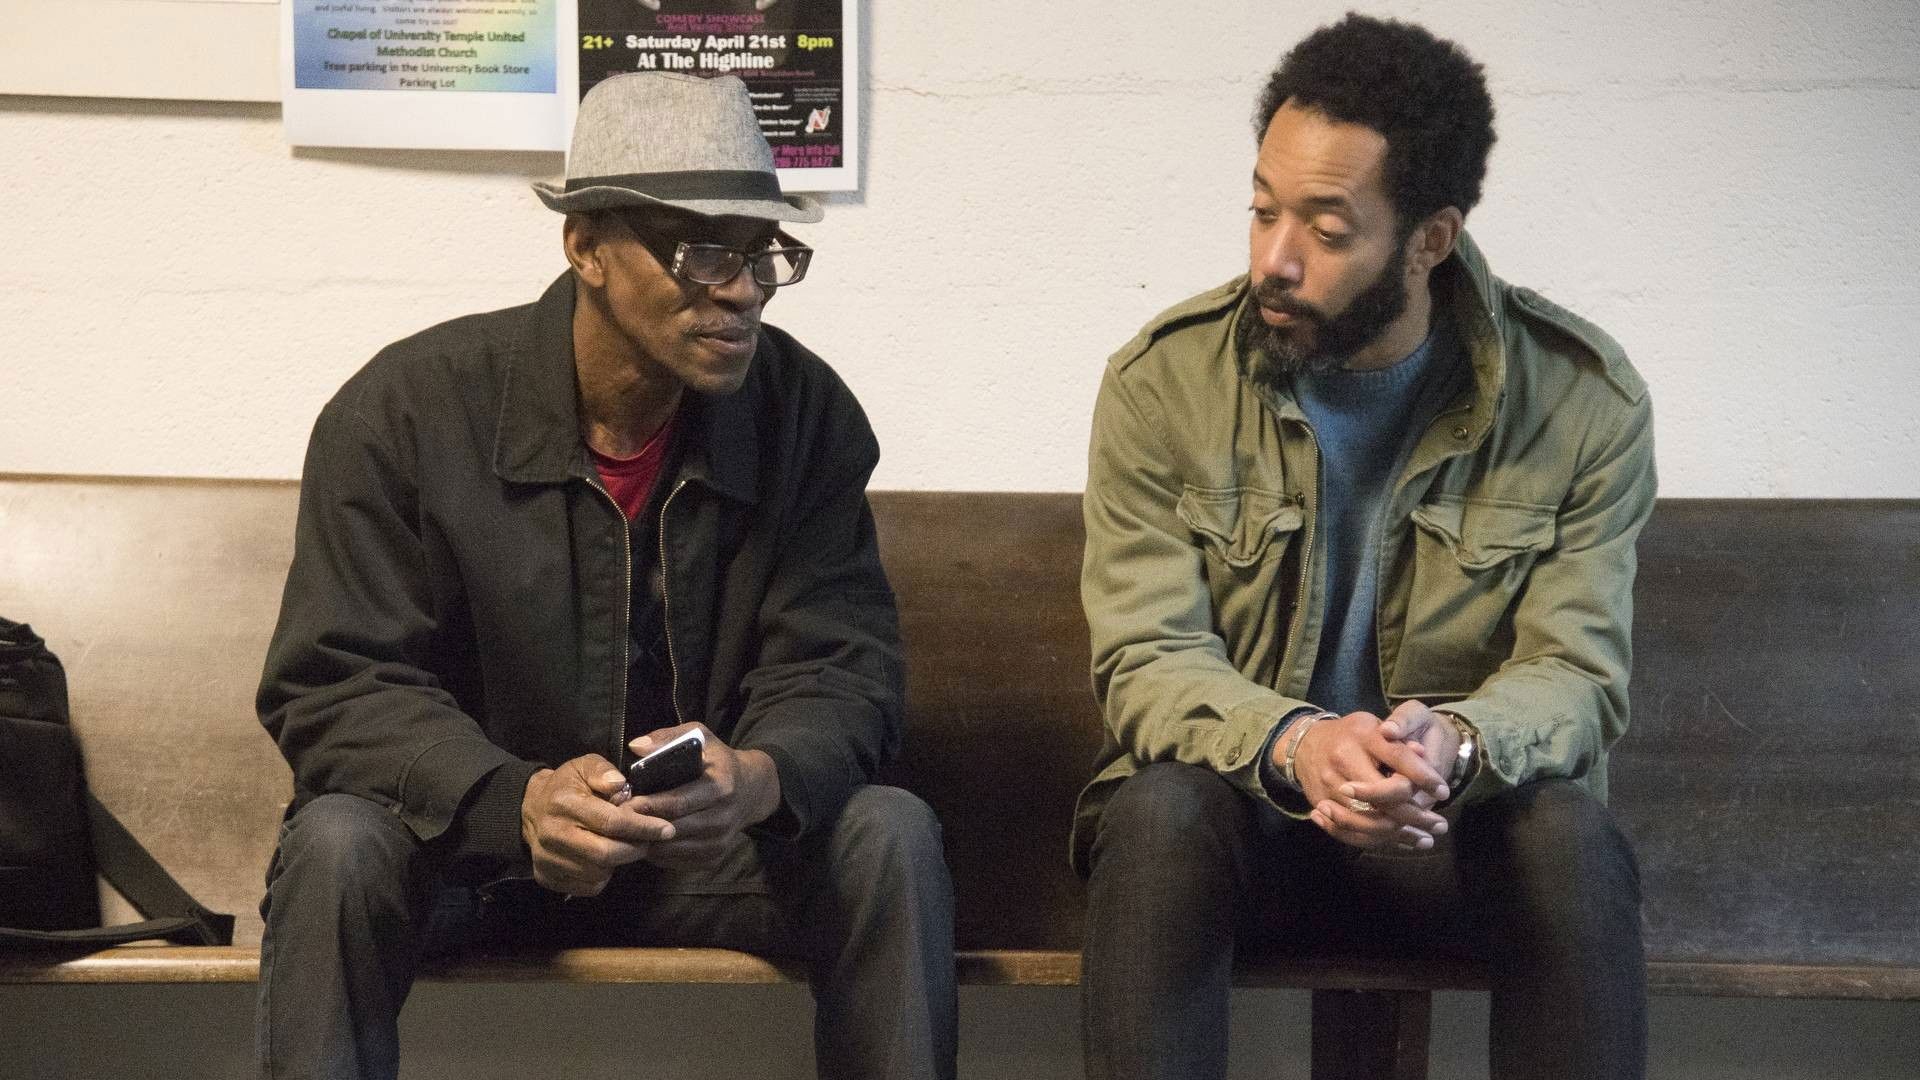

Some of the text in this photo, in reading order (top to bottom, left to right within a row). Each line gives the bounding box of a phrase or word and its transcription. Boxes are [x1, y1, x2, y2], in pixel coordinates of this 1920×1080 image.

[656, 15, 701, 24] COMEDY
[327, 27, 525, 44] Chapel of University Temple United
[582, 34, 834, 52] 21+ Saturday April 21st 8pm
[377, 46, 477, 58] Methodist Church
[324, 61, 530, 75] Free parking in the University Book Store
[637, 52, 775, 72] At The Highline
[400, 78, 456, 89] Parking Lot
